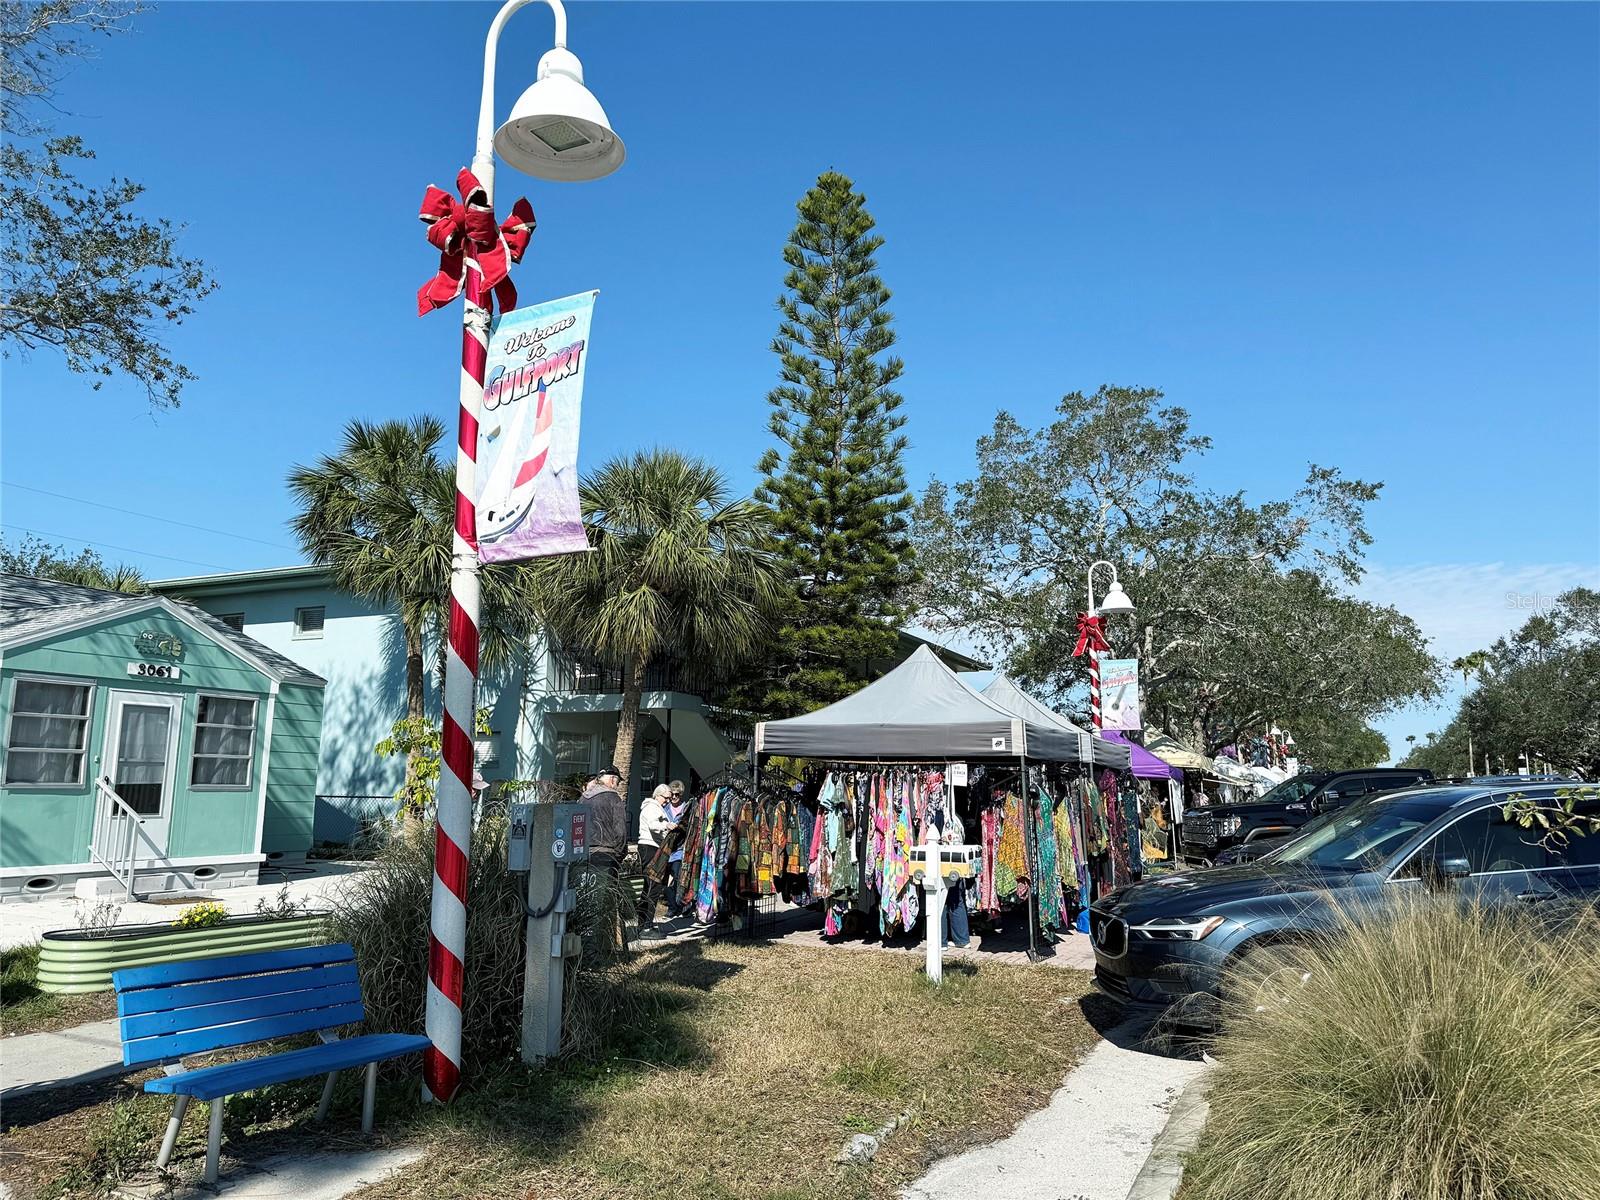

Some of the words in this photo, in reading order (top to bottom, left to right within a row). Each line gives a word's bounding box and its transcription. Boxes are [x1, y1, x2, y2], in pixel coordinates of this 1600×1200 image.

[504, 315, 576, 355] Welcome
[527, 343, 546, 361] To
[483, 340, 585, 411] GULFPORT
[138, 663, 172, 678] 3061
[573, 815, 585, 823] EVENT
